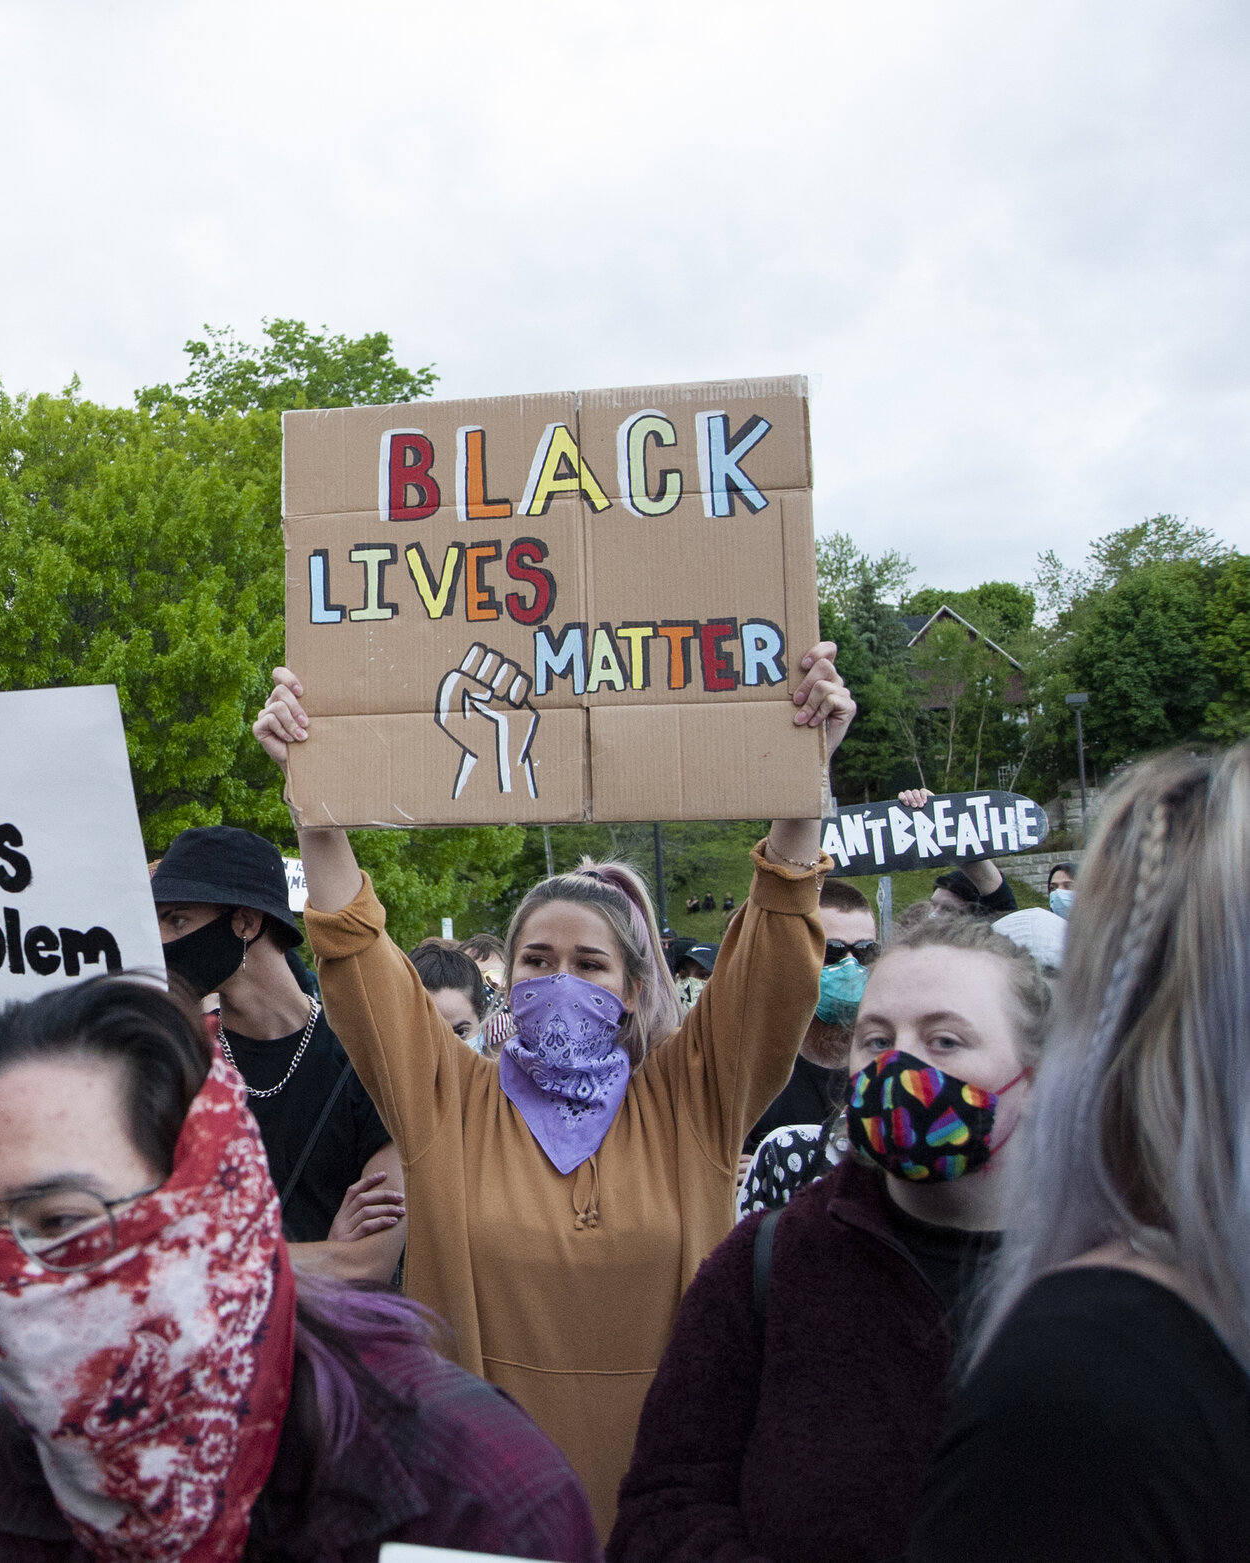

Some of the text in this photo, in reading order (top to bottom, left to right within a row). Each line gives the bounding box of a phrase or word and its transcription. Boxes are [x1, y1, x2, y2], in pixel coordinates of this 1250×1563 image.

[379, 409, 773, 522] BLACK
[309, 537, 557, 626] LIVES
[533, 617, 788, 696] MATTER
[888, 796, 1039, 858] BREATHE
